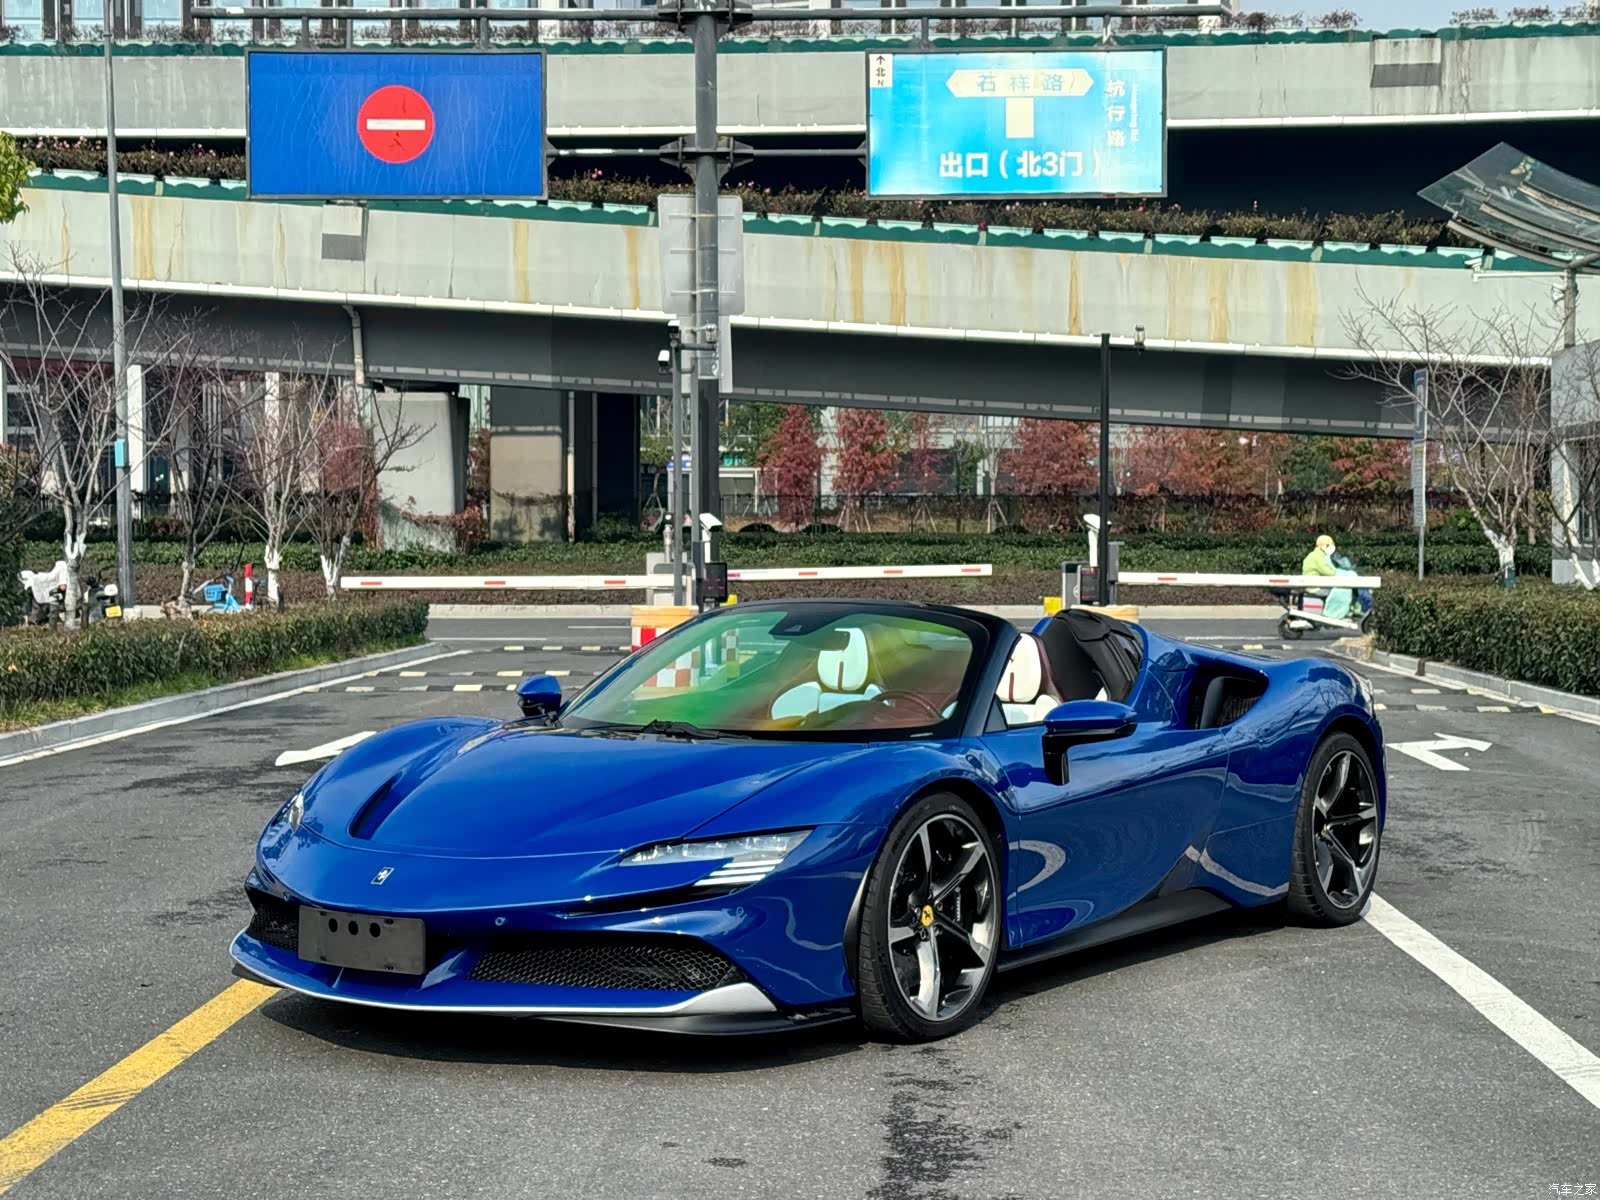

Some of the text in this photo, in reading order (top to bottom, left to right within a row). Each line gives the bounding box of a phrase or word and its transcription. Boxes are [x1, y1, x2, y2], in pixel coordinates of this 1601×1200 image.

[876, 67, 886, 77] 北
[977, 73, 1064, 93] 石祥路
